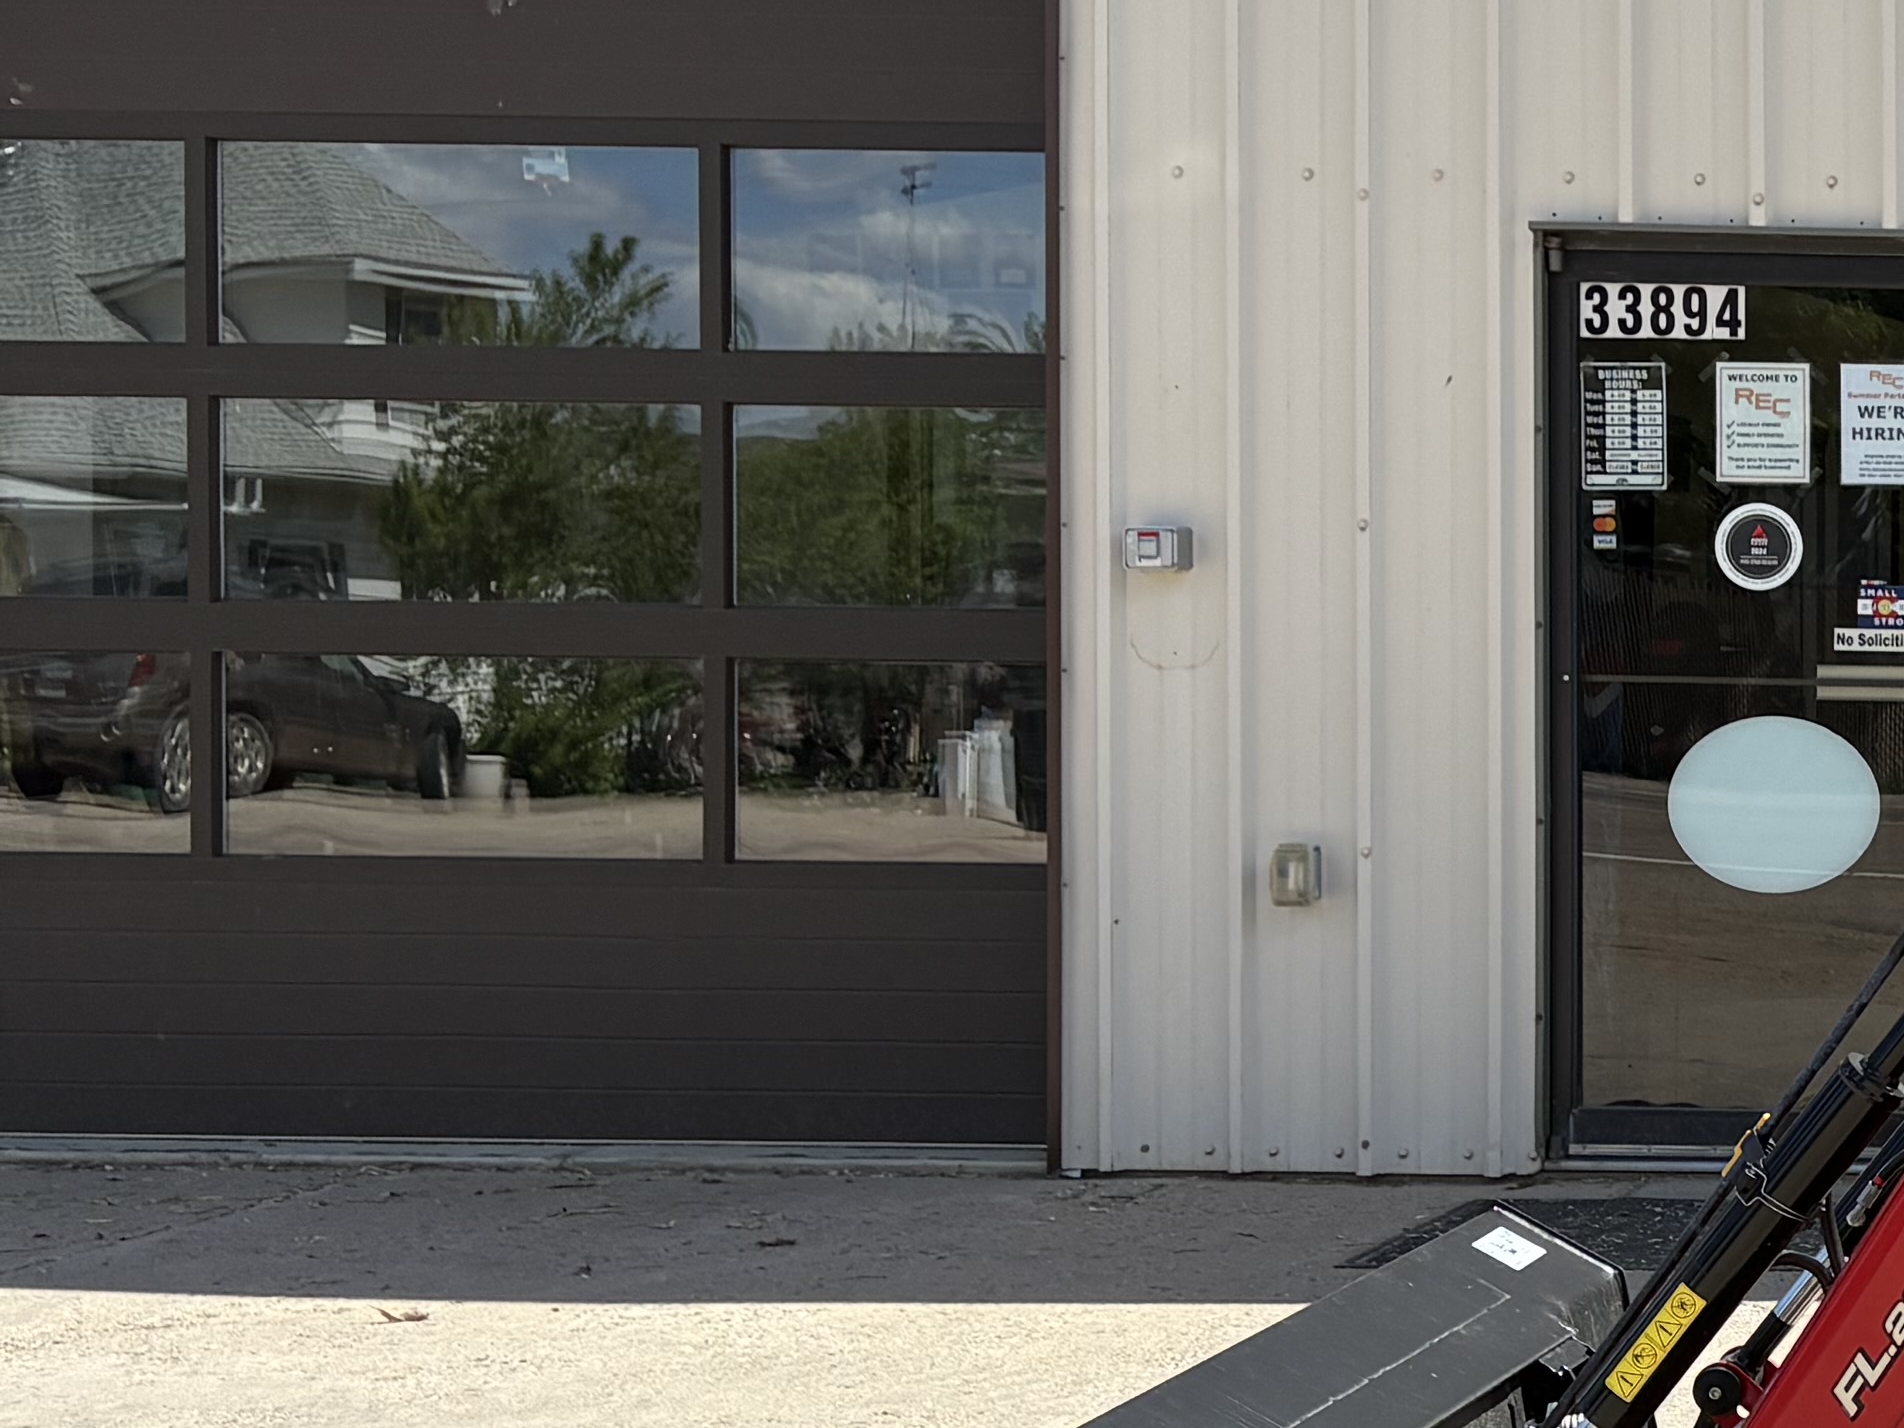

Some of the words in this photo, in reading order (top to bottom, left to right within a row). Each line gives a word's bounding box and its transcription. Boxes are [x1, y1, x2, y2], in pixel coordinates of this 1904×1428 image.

[1583, 284, 1743, 337] 33894
[1598, 369, 1648, 380] BUSINESS
[1727, 373, 1780, 383] WELCOME
[1784, 374, 1798, 383] TO
[1734, 387, 1791, 419] REC
[1860, 588, 1898, 597] SMALL
[1836, 633, 1854, 646] No
